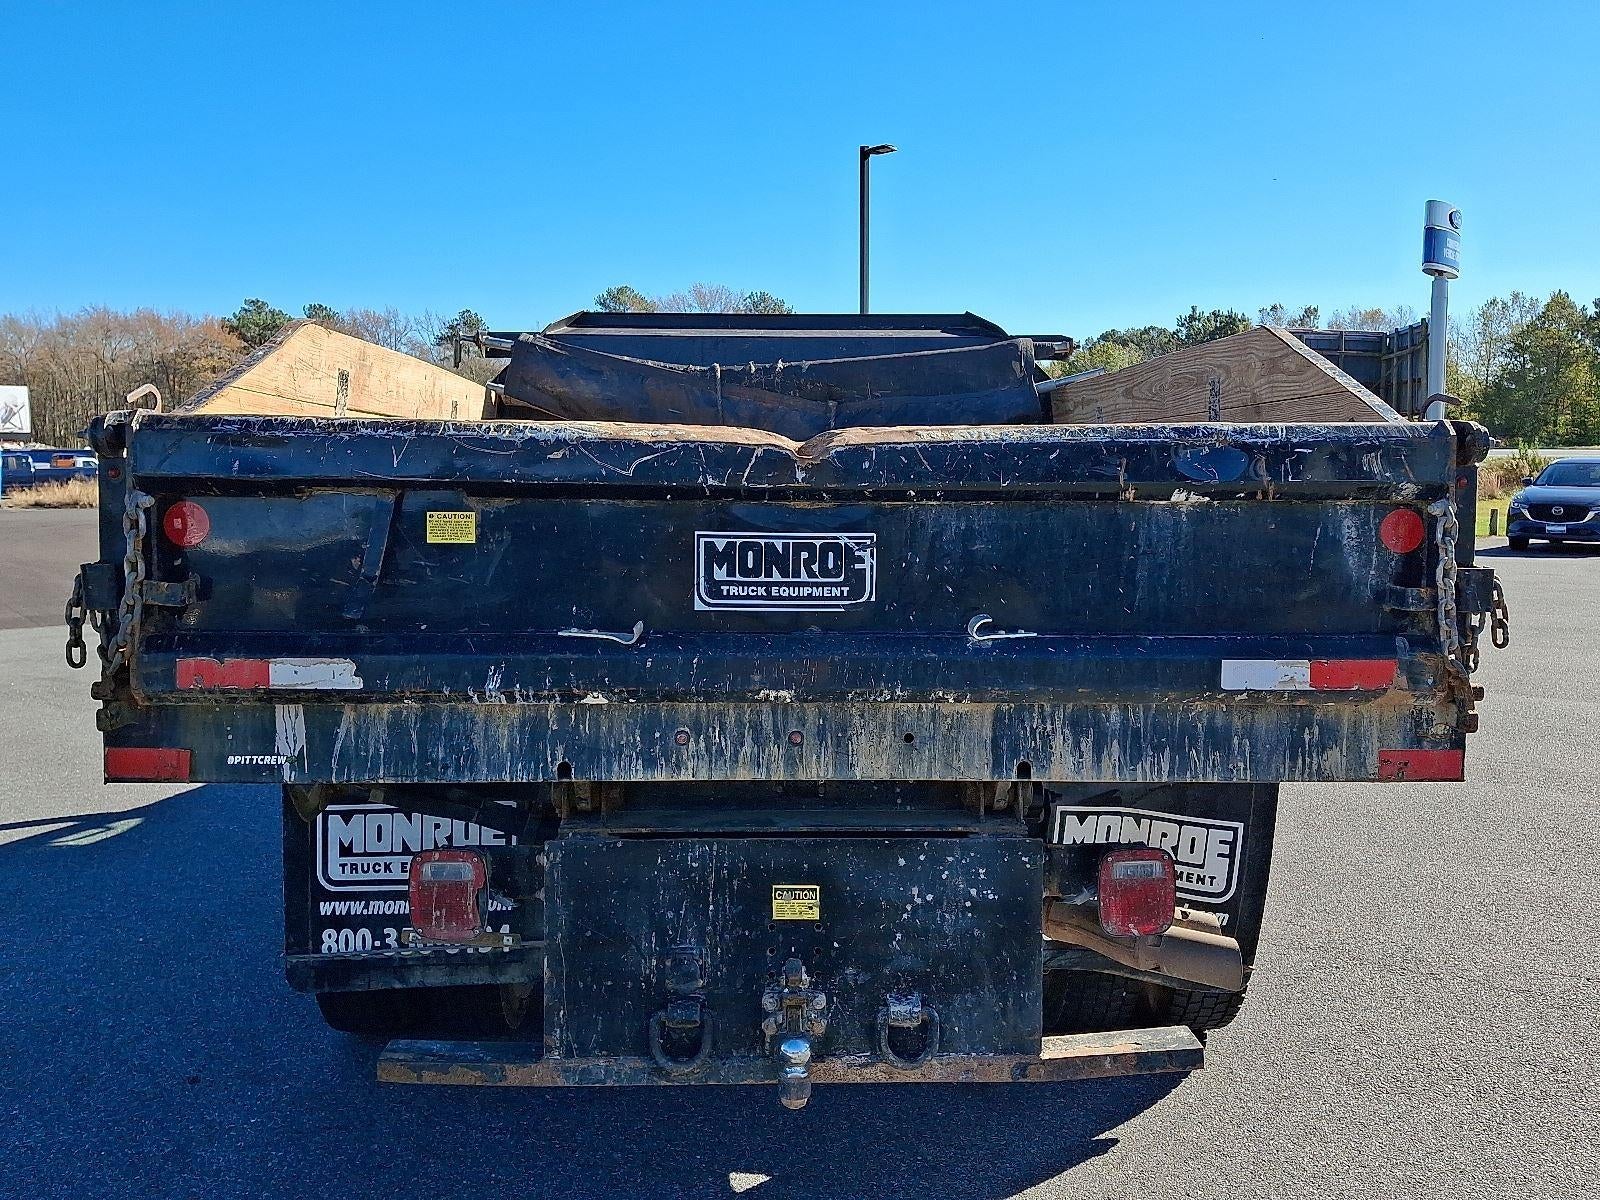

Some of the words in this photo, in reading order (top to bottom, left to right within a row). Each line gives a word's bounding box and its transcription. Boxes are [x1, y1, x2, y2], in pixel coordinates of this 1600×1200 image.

[704, 541, 869, 579] MONROE
[720, 586, 767, 597] TRUCK
[770, 586, 850, 597] EQUIPMENT
[1063, 815, 1234, 866] MONROE
[339, 861, 393, 875] TRUCK
[775, 890, 816, 900] CAUTION
